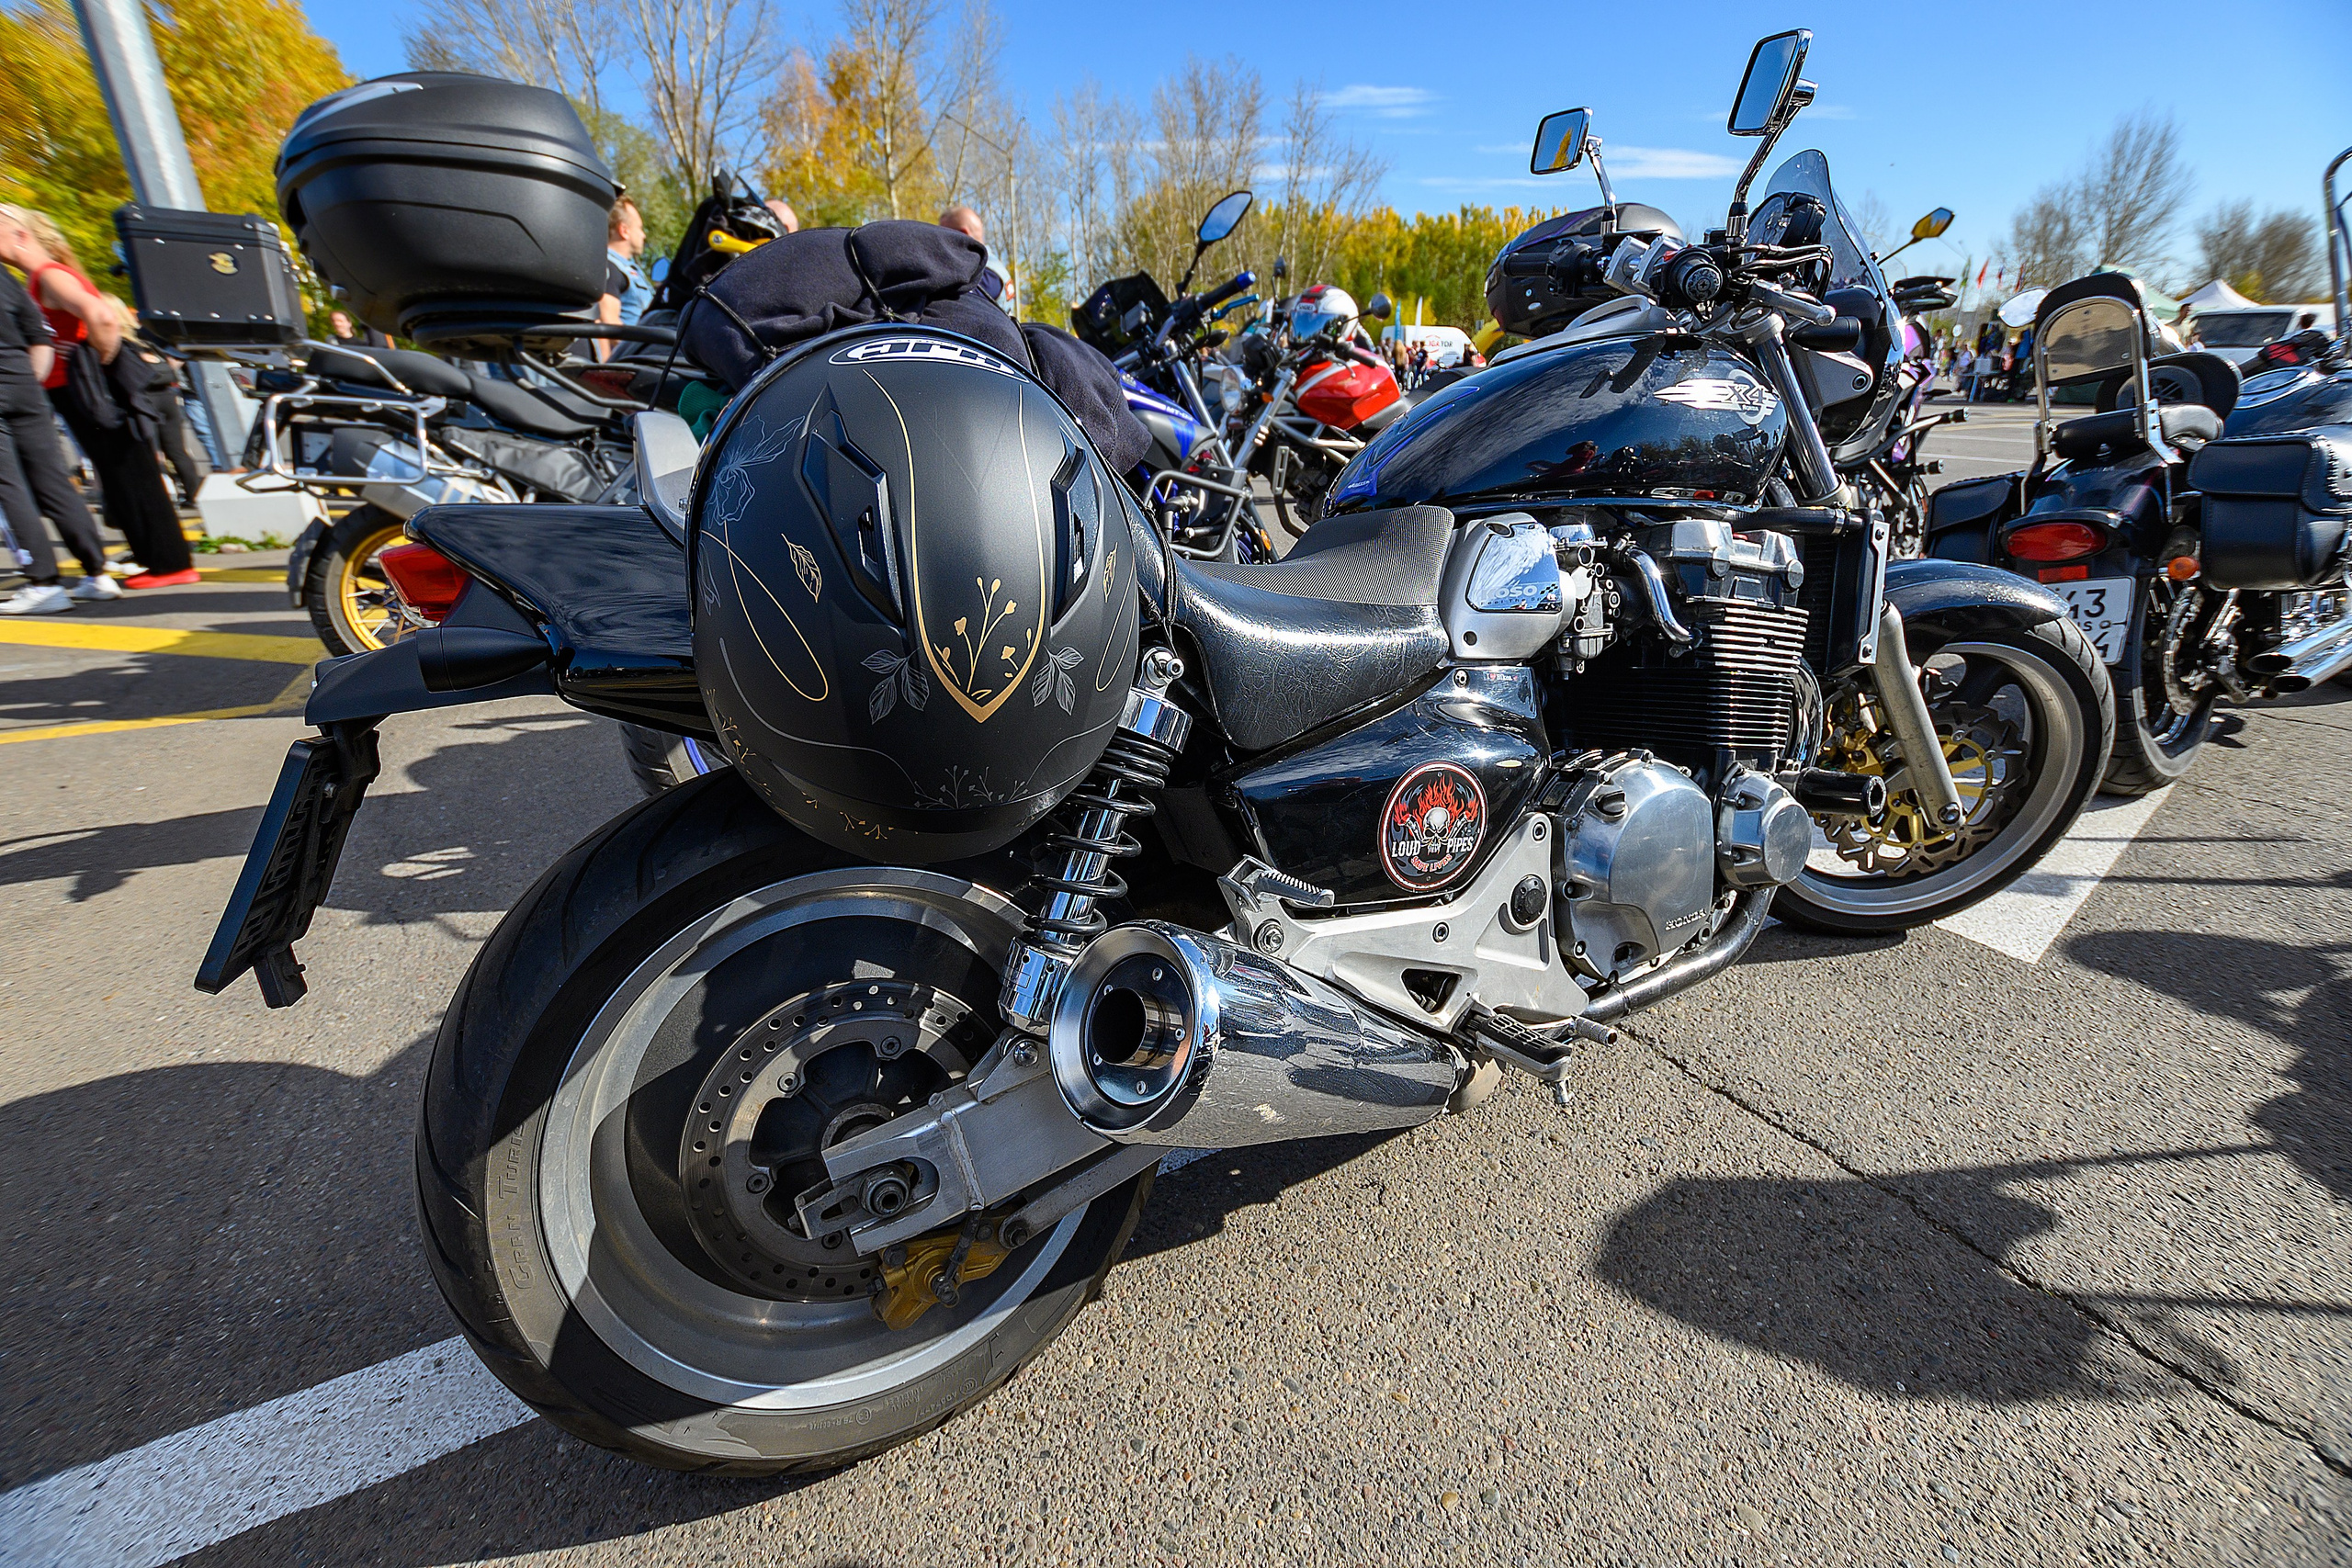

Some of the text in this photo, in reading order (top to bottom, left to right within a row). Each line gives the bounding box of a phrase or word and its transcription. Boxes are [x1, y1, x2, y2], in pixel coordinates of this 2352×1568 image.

[1724, 385, 1765, 405] X4
[1391, 836, 1475, 857] LOUD PIPES
[1665, 908, 1707, 931] HONDA
[498, 1115, 527, 1200] TURIS
